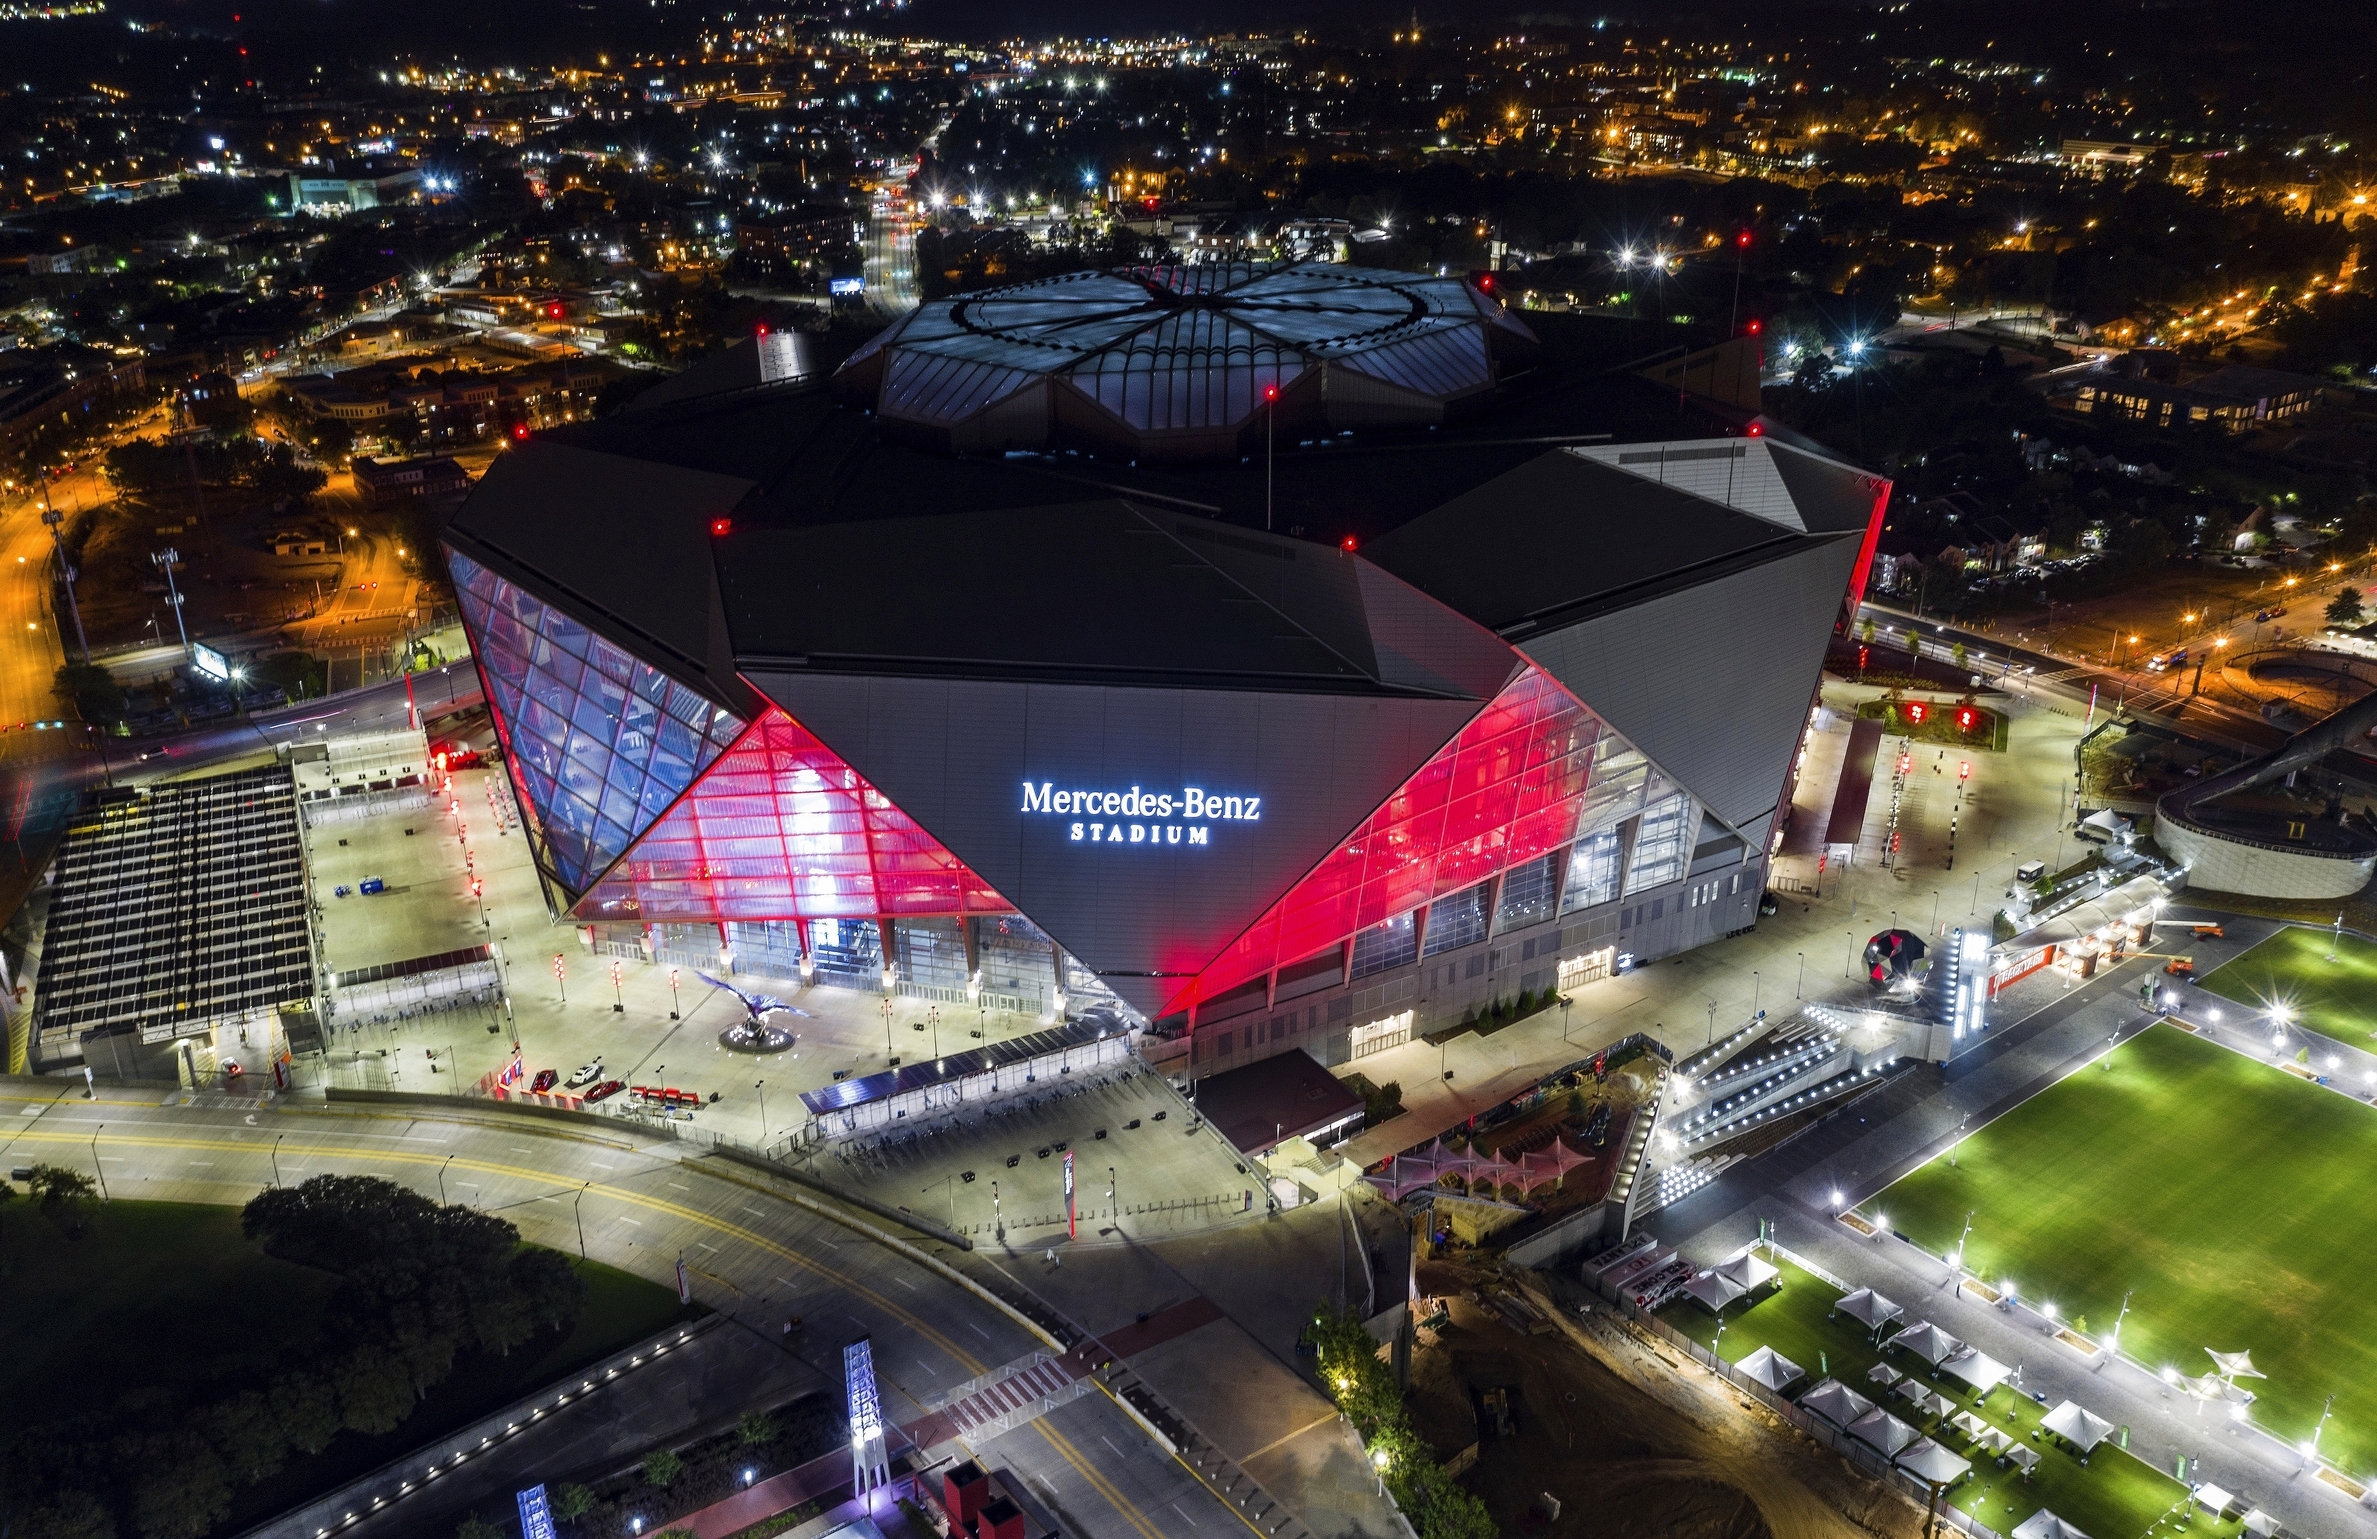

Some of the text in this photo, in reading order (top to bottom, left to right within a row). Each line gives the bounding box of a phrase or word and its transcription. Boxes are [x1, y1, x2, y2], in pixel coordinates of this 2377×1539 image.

[1021, 782, 1260, 820] Mercedes-Benz
[1071, 823, 1208, 844] STADIUM
[1591, 1235, 1647, 1267] ATLANTA
[1631, 1260, 1690, 1293] WELCOME
